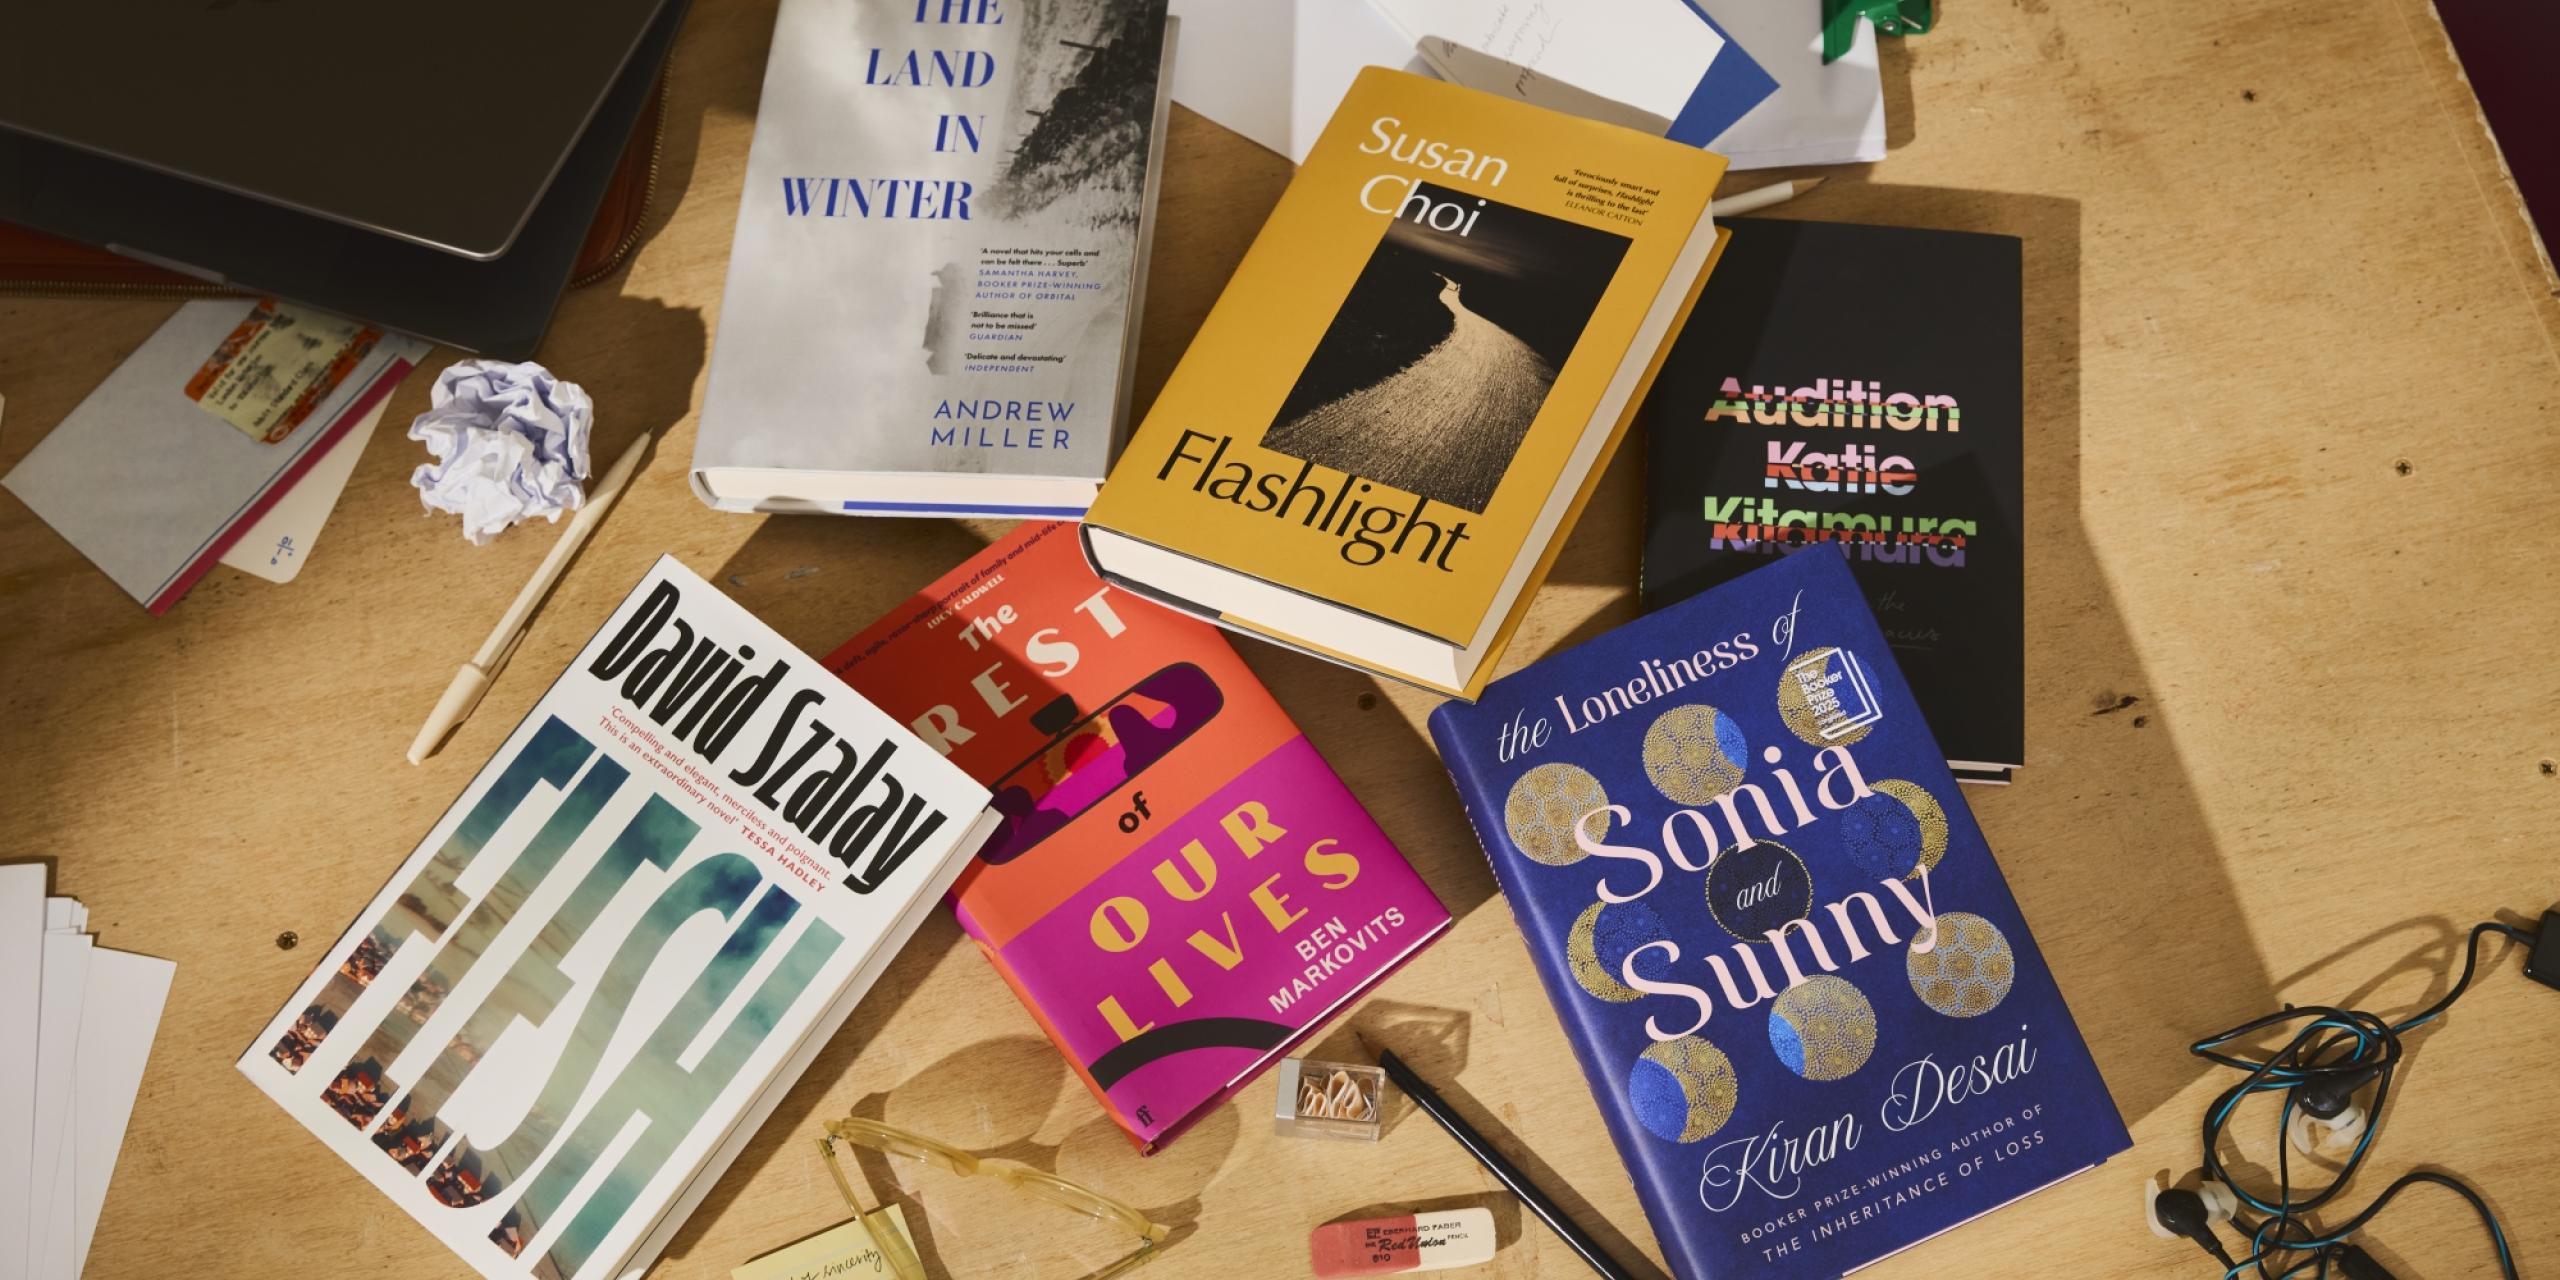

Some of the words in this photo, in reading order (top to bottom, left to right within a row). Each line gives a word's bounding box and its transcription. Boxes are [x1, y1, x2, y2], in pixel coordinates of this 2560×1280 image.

[865, 48, 995, 88] LAND
[932, 114, 986, 154] IN
[1359, 116, 1510, 188] Susan
[780, 176, 973, 220] WINTER
[1359, 174, 1488, 238] Choi
[1553, 174, 1568, 184] full
[1616, 190, 1655, 206] Flashlight
[1564, 200, 1606, 217] ELEANOR
[1606, 211, 1644, 226] CATTON
[1618, 202, 1630, 212] the
[1620, 182, 1643, 192] smart
[1644, 188, 1660, 197] and
[975, 292, 1016, 300] AUTHOR
[979, 269, 1034, 277] SAMANTHA
[1020, 281, 1102, 290] PRIZE-WINNING
[969, 333, 1022, 341] GUARDIAN
[964, 364, 1034, 373] INDEPENDENT
[934, 399, 1076, 423] ANDREW
[1704, 376, 1961, 432] Audition
[930, 427, 1072, 451] MILLER
[1764, 440, 1919, 496] Katie
[1155, 427, 1473, 573] Flashlight
[1704, 496, 1977, 568] Kitamura
[937, 580, 973, 611] portrait
[970, 574, 980, 586] of
[981, 558, 1008, 578] family
[1008, 544, 1024, 560] and
[1024, 524, 1057, 550] mid-life
[927, 608, 953, 630] LUCY
[954, 574, 1006, 610] CALDWELL
[958, 604, 1019, 652] The
[910, 586, 1128, 757] REST
[1496, 707, 1552, 764] the
[1554, 630, 1760, 736] Loneliness
[1772, 588, 1803, 662] of
[1796, 669, 1818, 684] The
[1802, 670, 1843, 694] Booker
[1807, 688, 1836, 706] Prize
[1812, 699, 1840, 716] 2025
[587, 578, 792, 766] David
[727, 688, 949, 896] Szalay
[598, 715, 618, 738] This
[618, 730, 628, 745] is
[628, 738, 642, 754] an
[642, 750, 708, 806] extraordinary
[740, 824, 776, 857] TESSA
[777, 854, 827, 894] HADLEY
[664, 748, 684, 768] and
[684, 758, 720, 797] elegant,
[722, 792, 768, 831] merciless
[767, 826, 788, 846] and
[786, 842, 832, 881] poignant.
[1117, 790, 1153, 834] of
[1573, 744, 1878, 905] Sonia
[1089, 799, 1288, 954] OUR
[1736, 862, 1782, 911] and
[1096, 838, 1361, 1045] LIVES
[1268, 906, 1407, 1016] MARKOVITS
[1294, 916, 1349, 963] BEN
[1621, 864, 1939, 1042] Sunny
[268, 713, 846, 1280] FLESH
[1699, 1112, 1864, 1213] Kiran
[1880, 1024, 2038, 1132] Desai
[1740, 1208, 1808, 1245] BOOKER
[1814, 1148, 1943, 1212] PRIZE-WINNING
[1950, 1116, 2017, 1153] AUTHOR
[2021, 1104, 2043, 1122] OF
[1762, 1236, 1802, 1264] THE
[1811, 1172, 1950, 1244] INHERITANCE
[1958, 1155, 1986, 1178] OF
[1994, 1129, 2046, 1163] LOSS
[1383, 1225, 1430, 1236] EBERHARD
[1432, 1221, 1462, 1230] FABER
